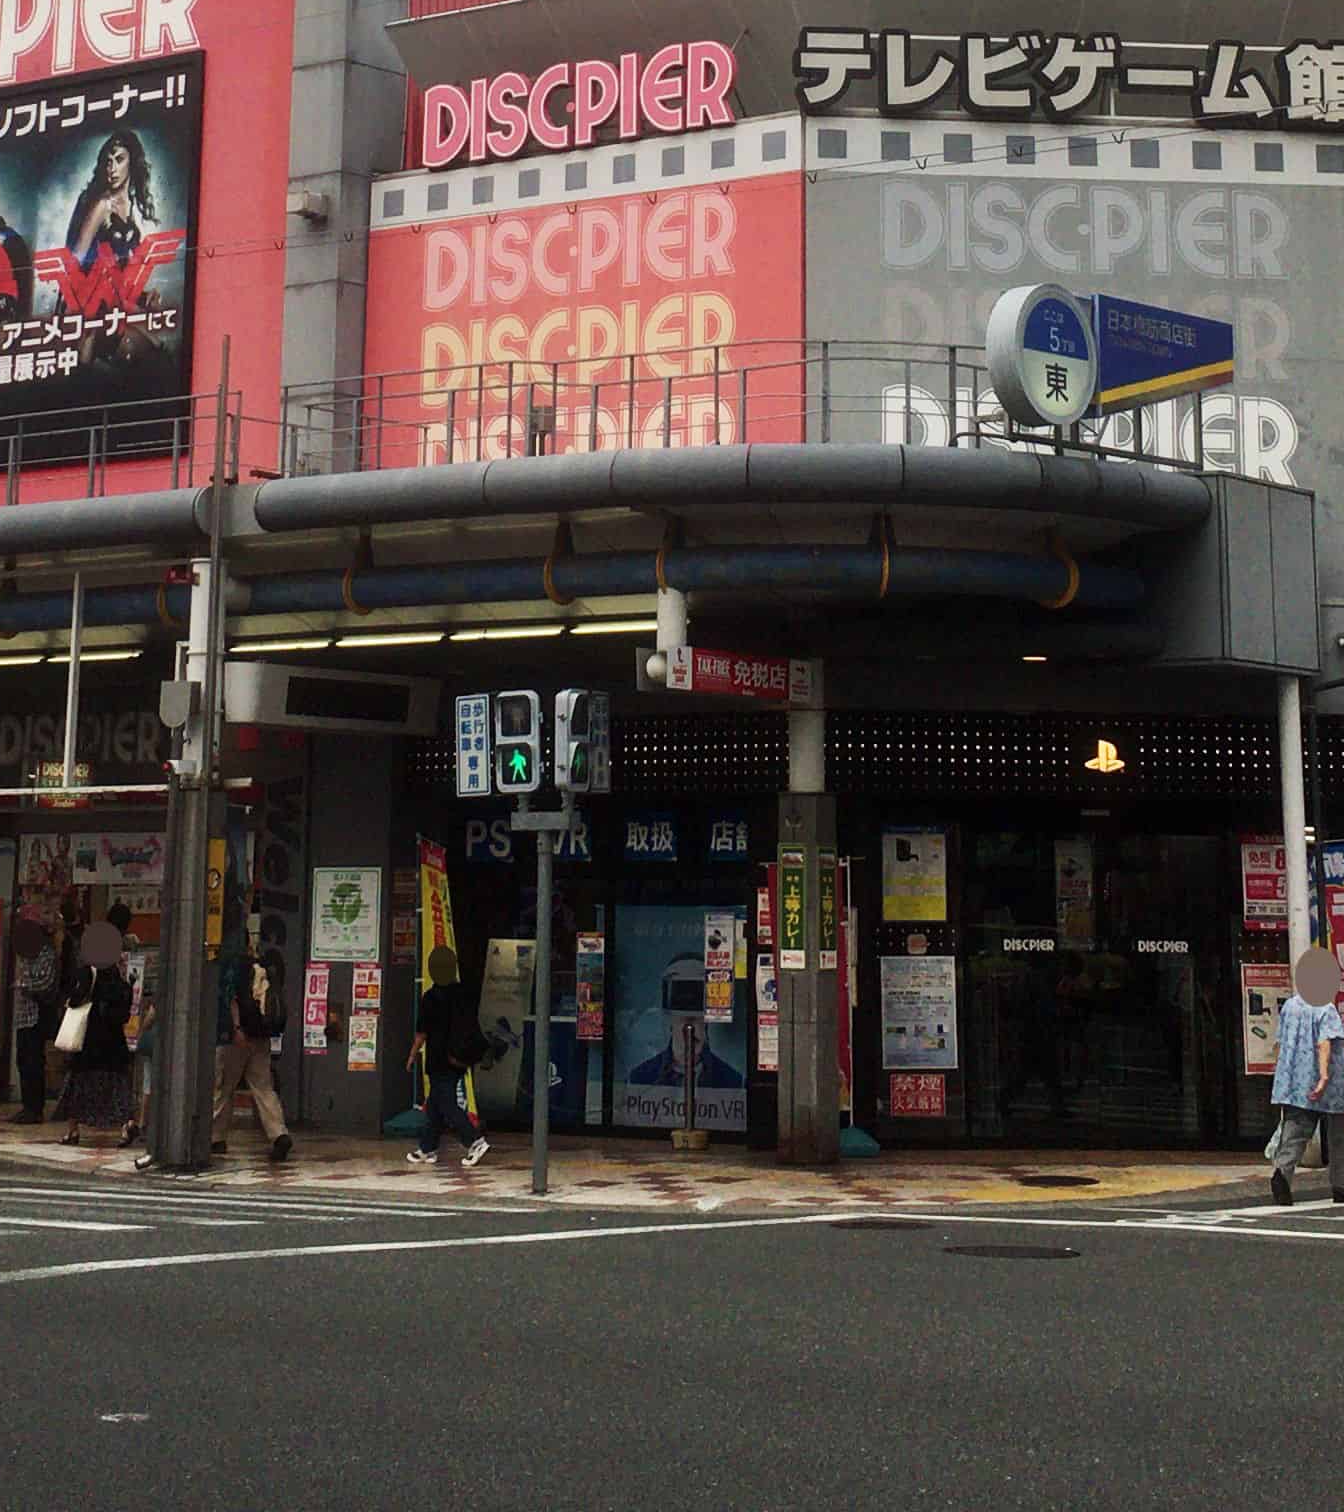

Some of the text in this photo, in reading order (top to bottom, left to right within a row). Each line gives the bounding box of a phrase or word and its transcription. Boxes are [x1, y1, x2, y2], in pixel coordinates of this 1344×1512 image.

[1045, 362, 1069, 403] 東
[733, 660, 787, 691] 免税店
[465, 819, 512, 858] PS
[624, 820, 673, 852] 取扱
[627, 1095, 746, 1122] PlayStaion VR
